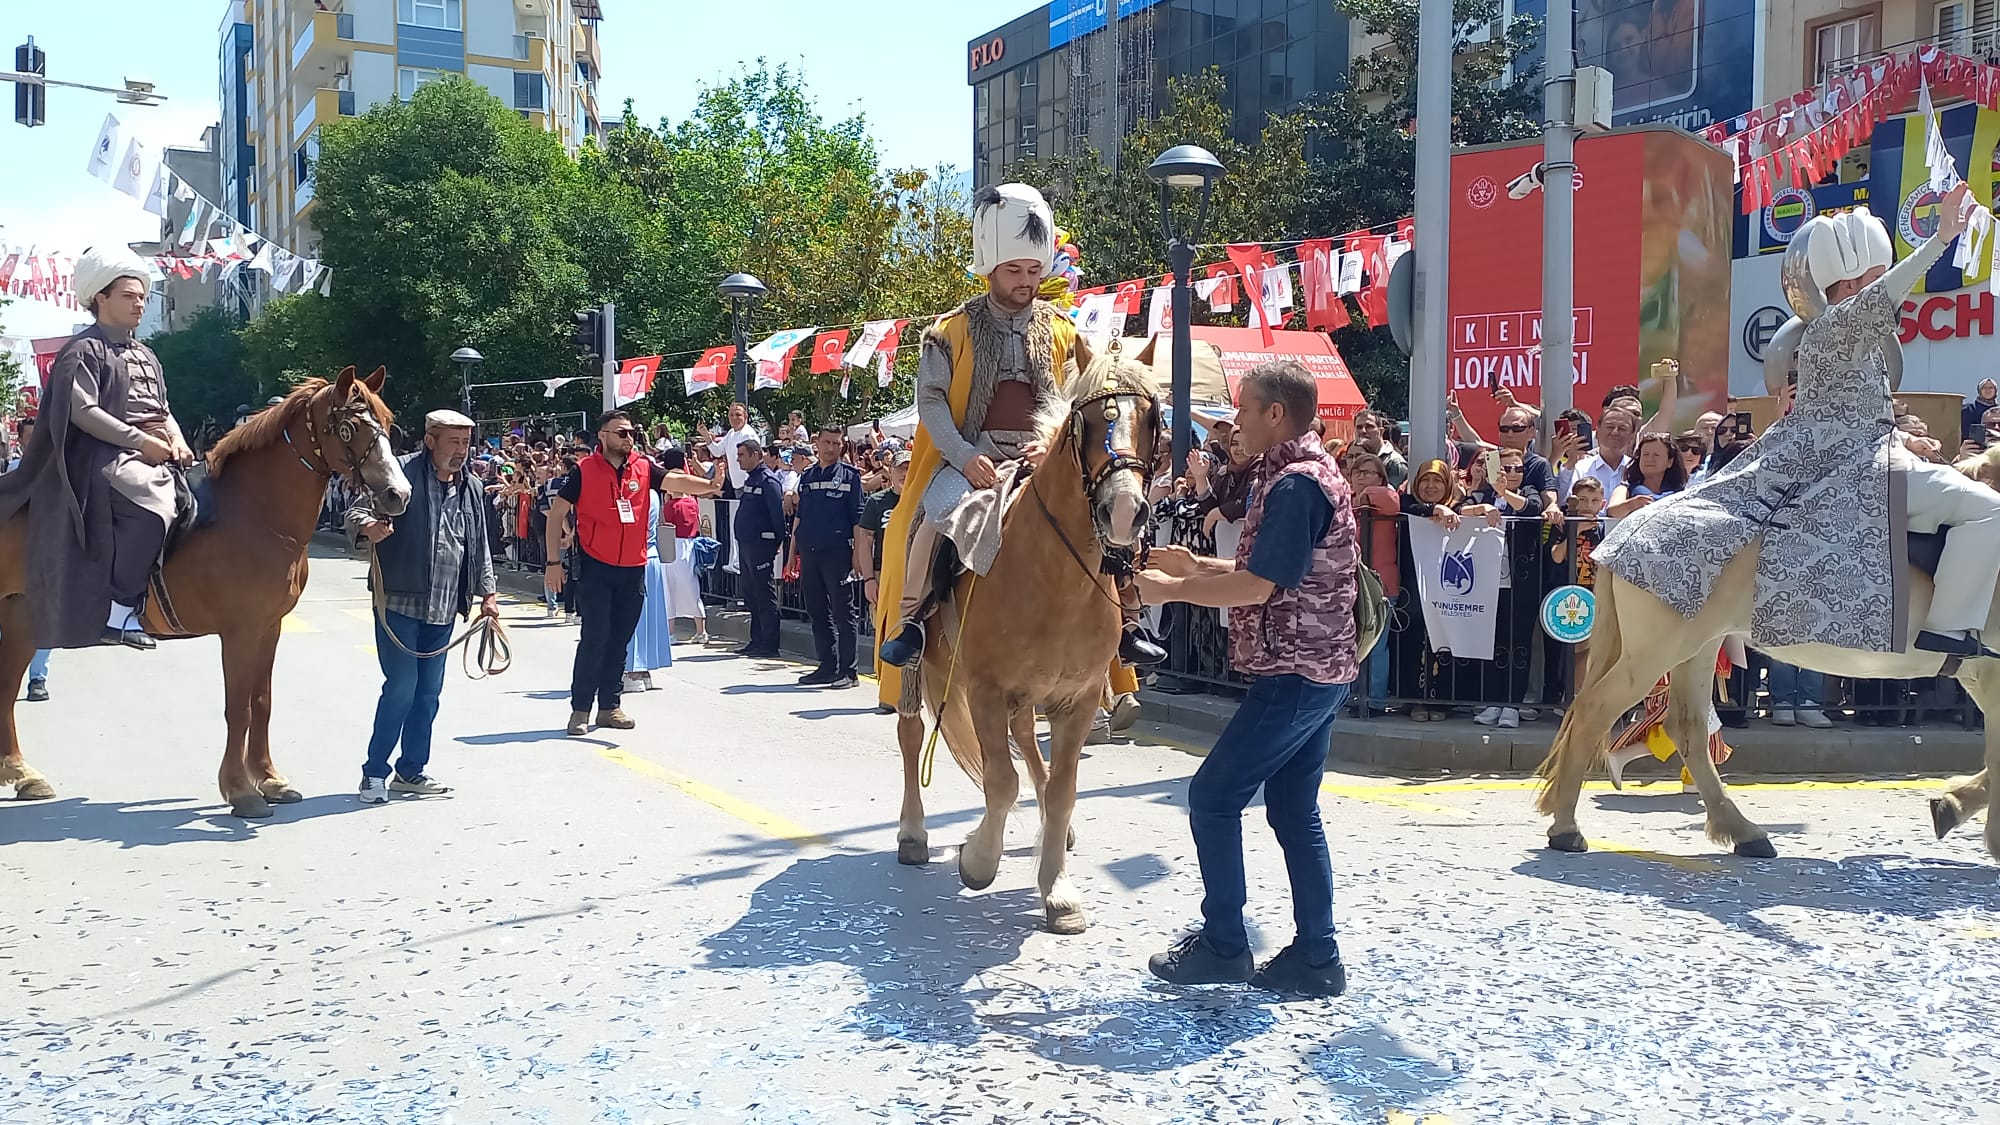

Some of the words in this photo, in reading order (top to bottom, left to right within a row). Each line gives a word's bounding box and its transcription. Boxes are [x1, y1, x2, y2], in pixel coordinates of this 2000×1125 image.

[971, 37, 1003, 71] FLO
[1897, 291, 1994, 344] SCH
[1319, 406, 1345, 417] ANLIĞI
[1432, 600, 1485, 613] YUNUSEMRE
